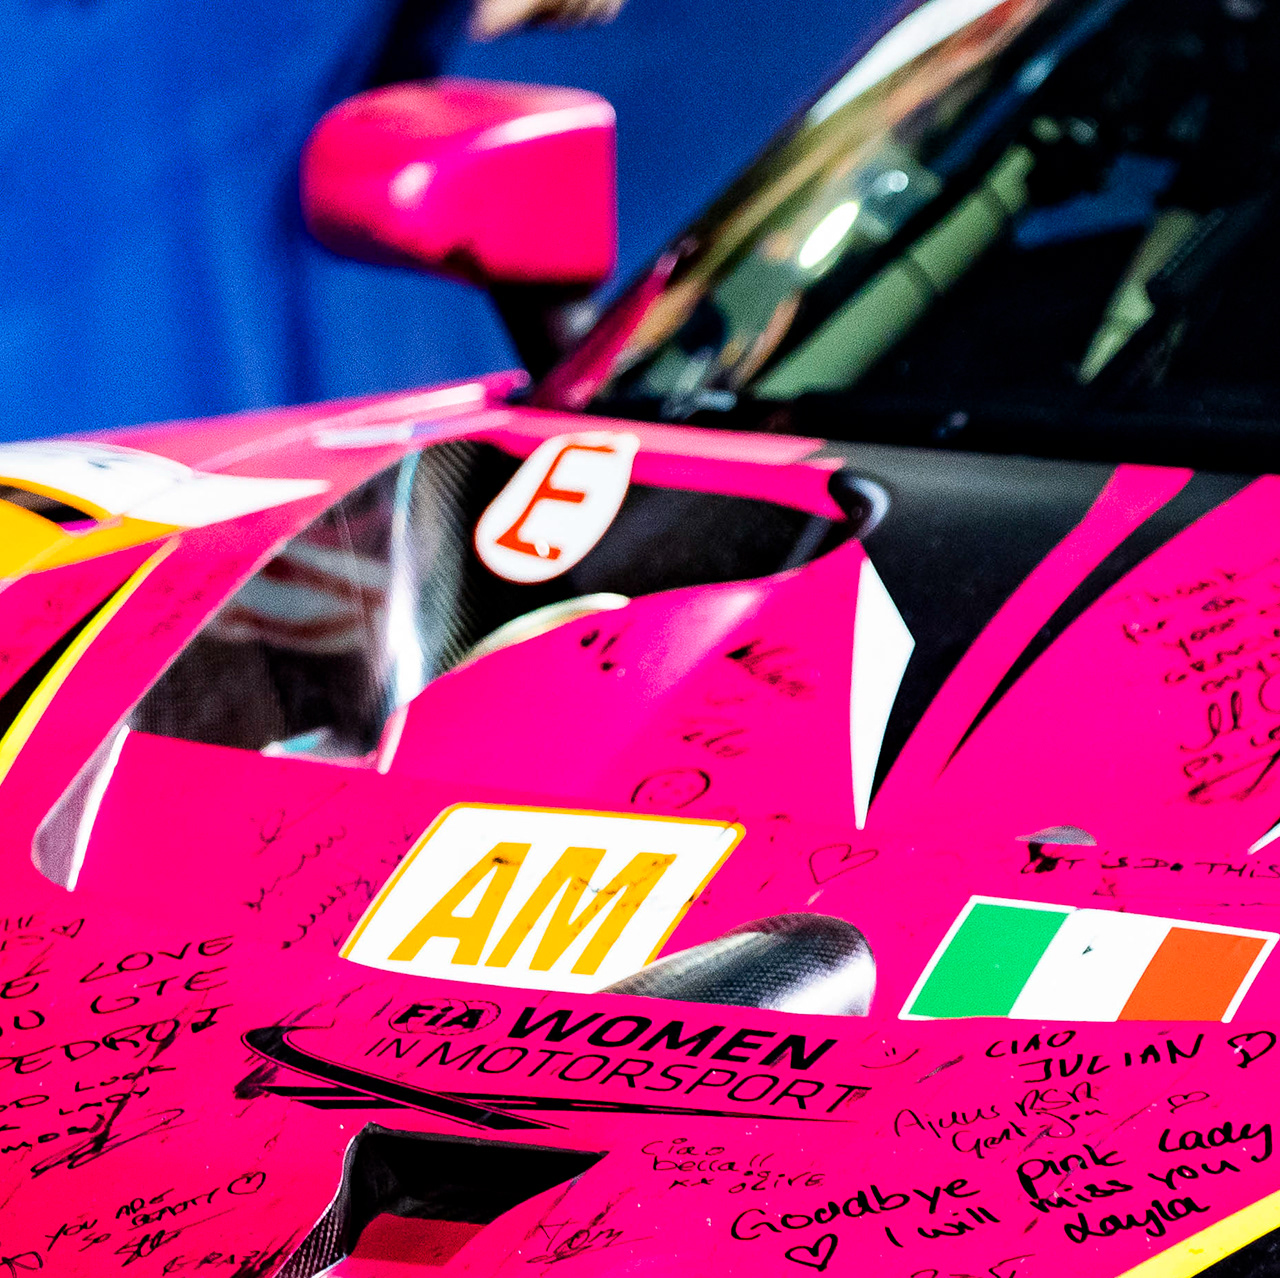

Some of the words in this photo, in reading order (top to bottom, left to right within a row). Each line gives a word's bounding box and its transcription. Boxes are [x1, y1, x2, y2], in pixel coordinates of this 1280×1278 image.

[496, 444, 615, 560] E
[387, 842, 677, 975] AM
[79, 936, 234, 983] LOVE
[508, 1007, 837, 1070] WOMEN
[986, 1030, 1076, 1057] CIAO
[1019, 1034, 1205, 1083] JULIAN
[365, 1038, 420, 1058] IN
[416, 1041, 872, 1113] MOTORSPORT
[731, 1177, 982, 1241] Goodbye
[917, 1206, 1001, 1238] will
[1029, 1180, 1133, 1213] miss
